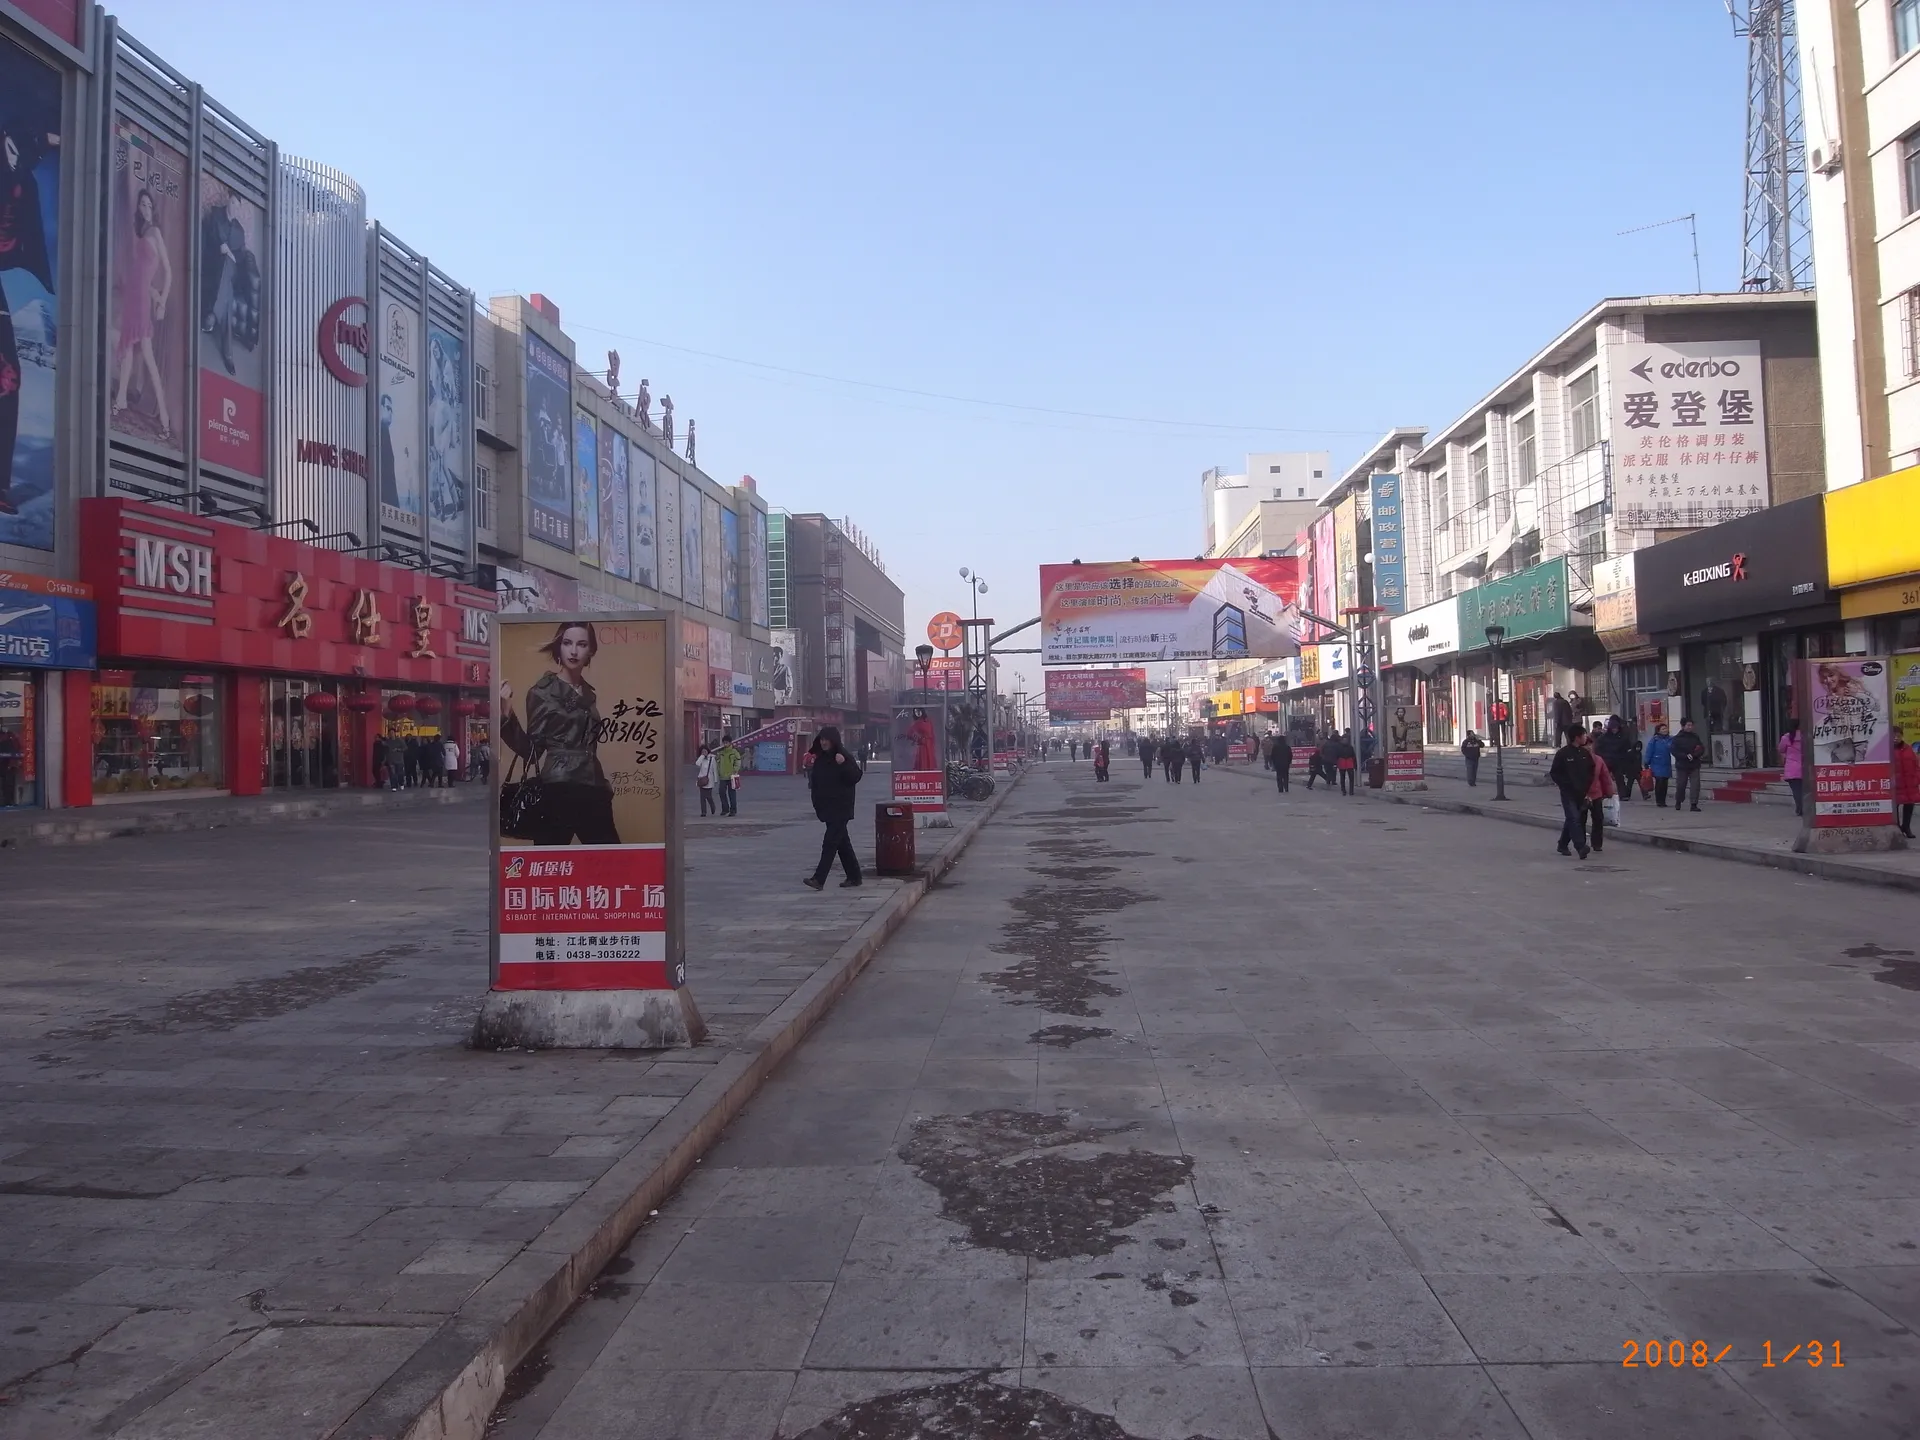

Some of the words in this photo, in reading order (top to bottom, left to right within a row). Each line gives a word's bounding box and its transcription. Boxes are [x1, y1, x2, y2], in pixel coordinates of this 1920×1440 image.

[380, 353, 415, 378] LEONARDO
[1623, 389, 1754, 429] 爱登堡
[208, 419, 228, 433] pierre
[229, 427, 249, 441] cardin
[1640, 433, 1745, 449] 英伦格调男装
[297, 438, 338, 468] MING
[1623, 454, 1669, 468] 派克服
[1679, 451, 1759, 467] 休闲牛仔裤
[1624, 473, 1680, 486] 牵手爱登堡
[1627, 508, 1761, 522] 创业热线：303222
[136, 537, 212, 597] MSH
[1683, 563, 1731, 587] K-BOXING
[1902, 590, 1920, 605] 361
[278, 571, 436, 659] 名仕皇
[463, 609, 489, 645] MS
[940, 624, 952, 637] D
[528, 861, 575, 877] 斯堡特
[503, 884, 666, 911] 国际购物广场
[542, 912, 600, 920] INTERNATIONAL
[644, 911, 663, 919] MALL
[535, 935, 641, 947] 地址：江北商业步行街
[535, 950, 641, 960] 电话：0438-3036222
